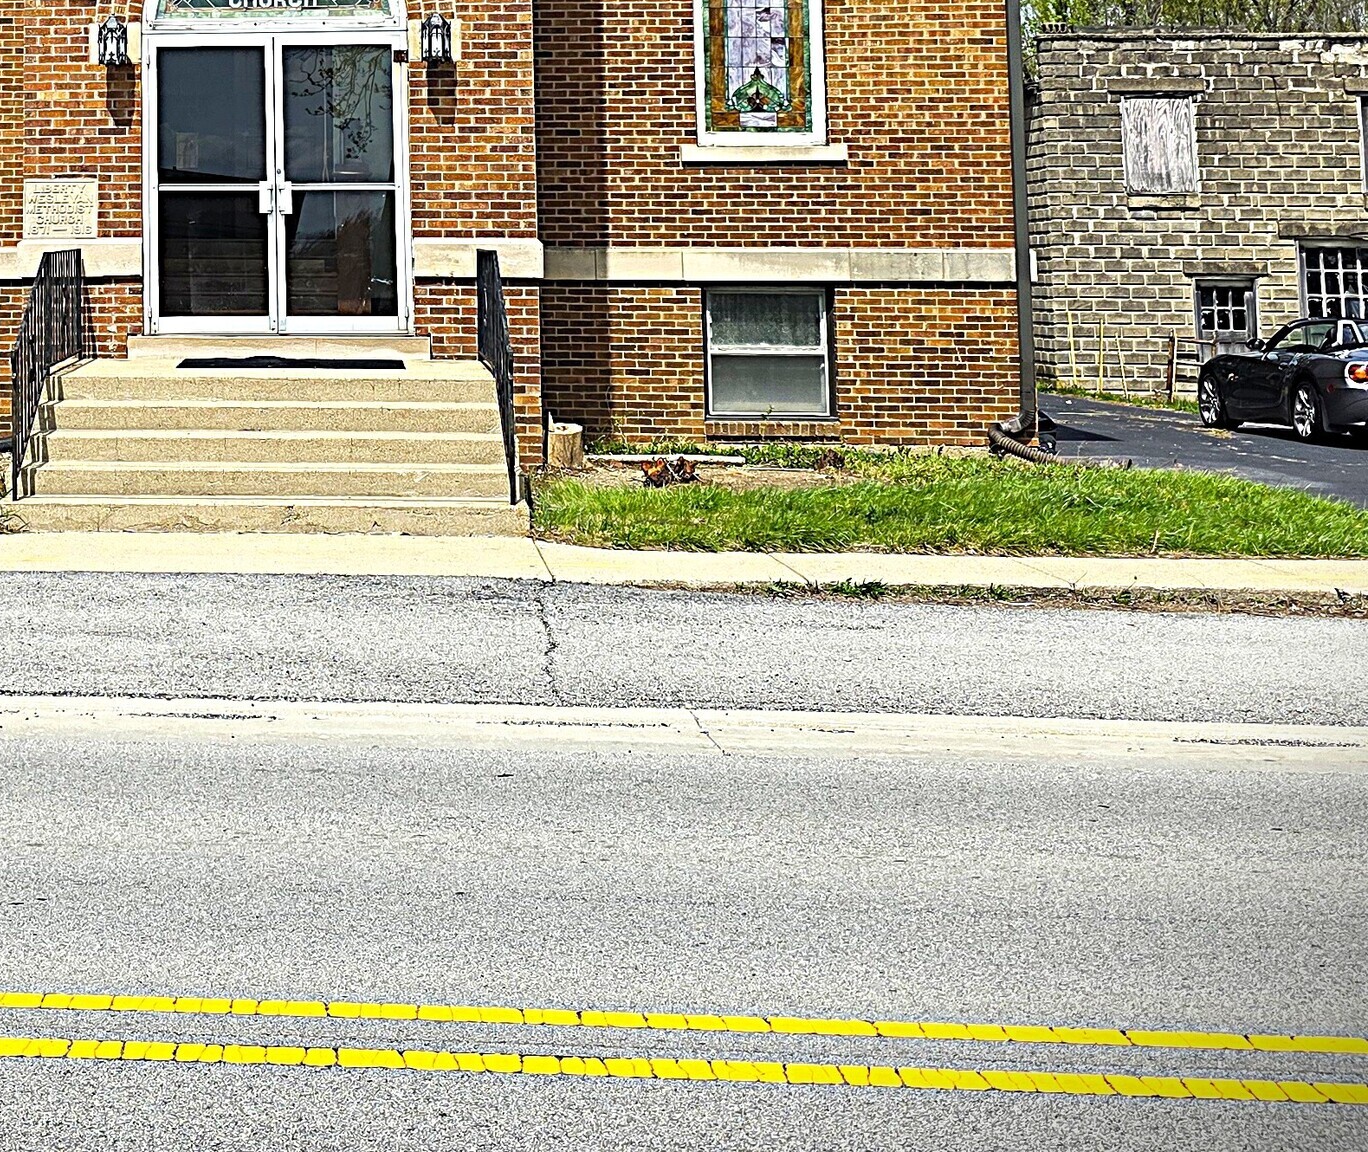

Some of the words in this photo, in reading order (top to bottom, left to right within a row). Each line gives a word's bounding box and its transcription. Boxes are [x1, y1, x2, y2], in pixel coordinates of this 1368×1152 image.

[33, 184, 87, 194] LIBERTY
[28, 194, 93, 204] WESLEYAN
[26, 205, 94, 215] METHODIST
[36, 215, 84, 225] CHURCH
